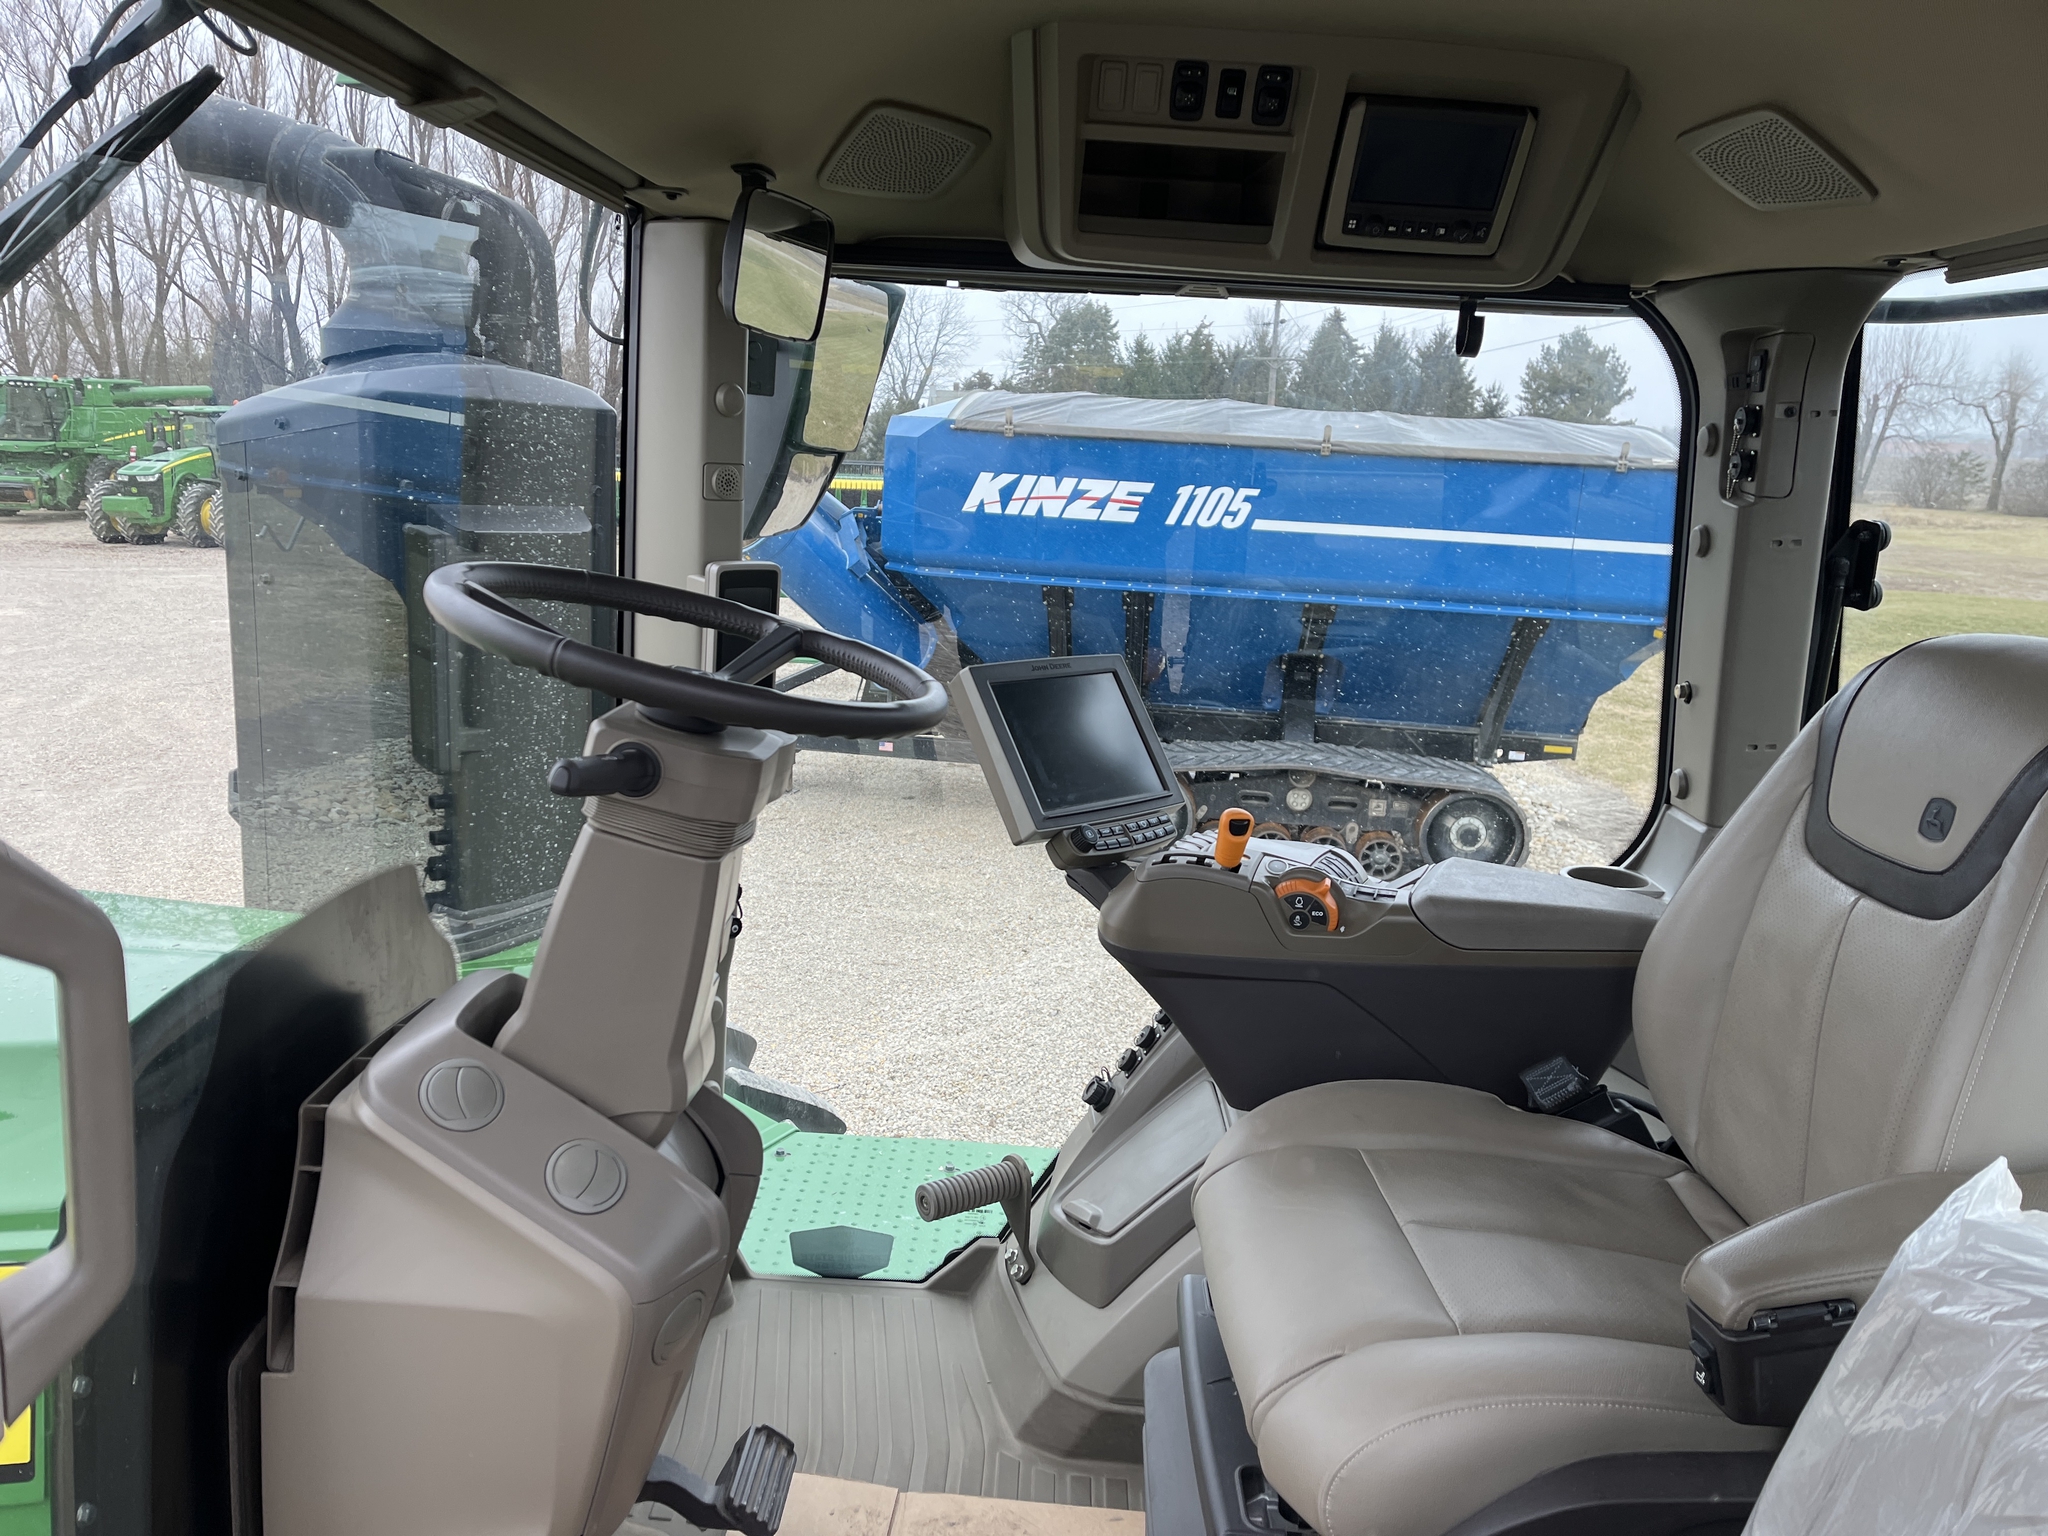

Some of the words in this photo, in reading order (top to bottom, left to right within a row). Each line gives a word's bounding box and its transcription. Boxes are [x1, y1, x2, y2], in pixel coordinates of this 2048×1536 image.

[961, 471, 1155, 523] KINZE
[1164, 484, 1261, 528] 1105
[1049, 662, 1072, 670] DEERE
